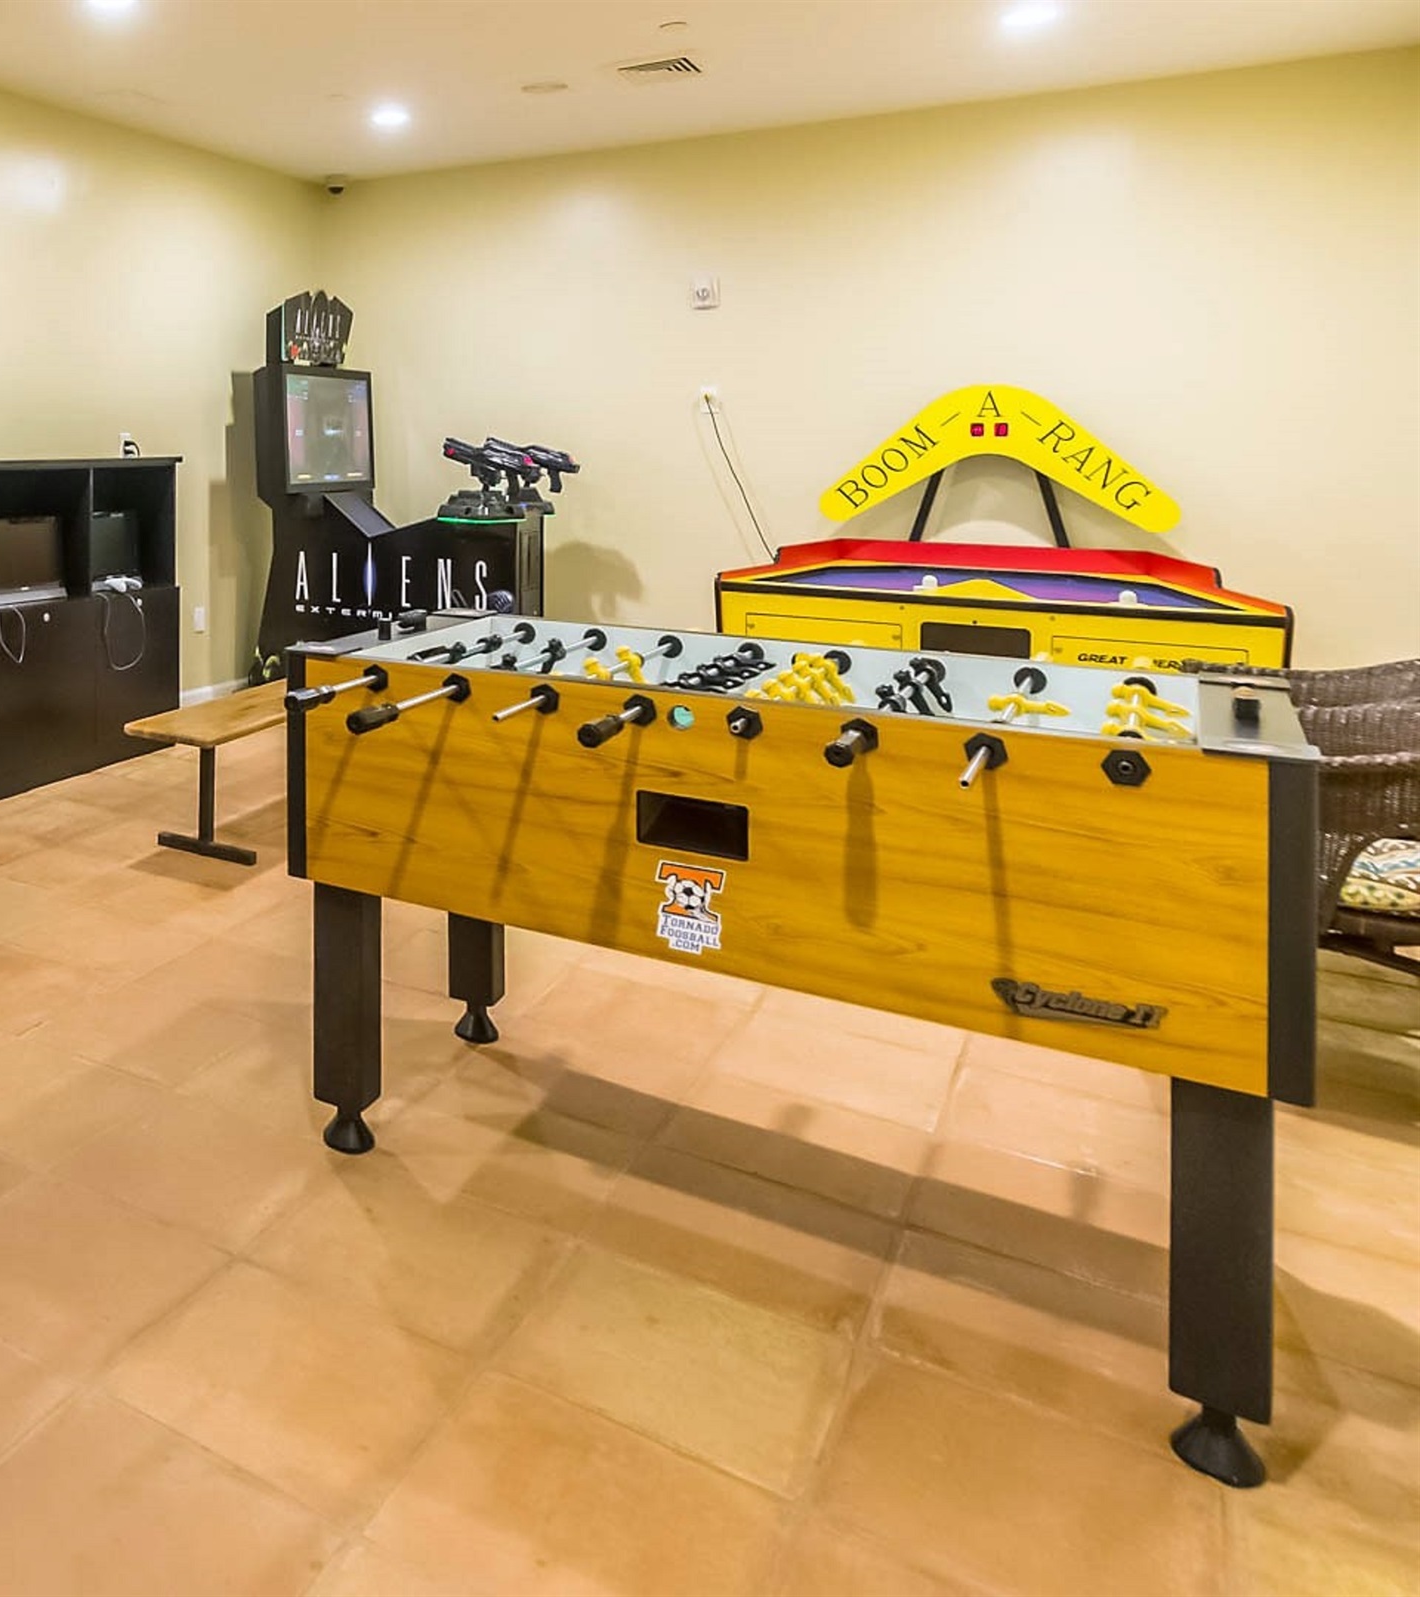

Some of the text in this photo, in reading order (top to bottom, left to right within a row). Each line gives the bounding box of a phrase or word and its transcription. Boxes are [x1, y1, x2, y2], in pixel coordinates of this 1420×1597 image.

[836, 424, 940, 508] BOOM
[976, 390, 1002, 418] A
[1036, 420, 1153, 510] RANG
[295, 542, 489, 611] ALIENS
[1077, 653, 1127, 665] GREAT
[659, 926, 720, 947] FOOSBALL
[661, 914, 720, 936] TORNADO
[1014, 981, 1129, 1020] Cyclone
